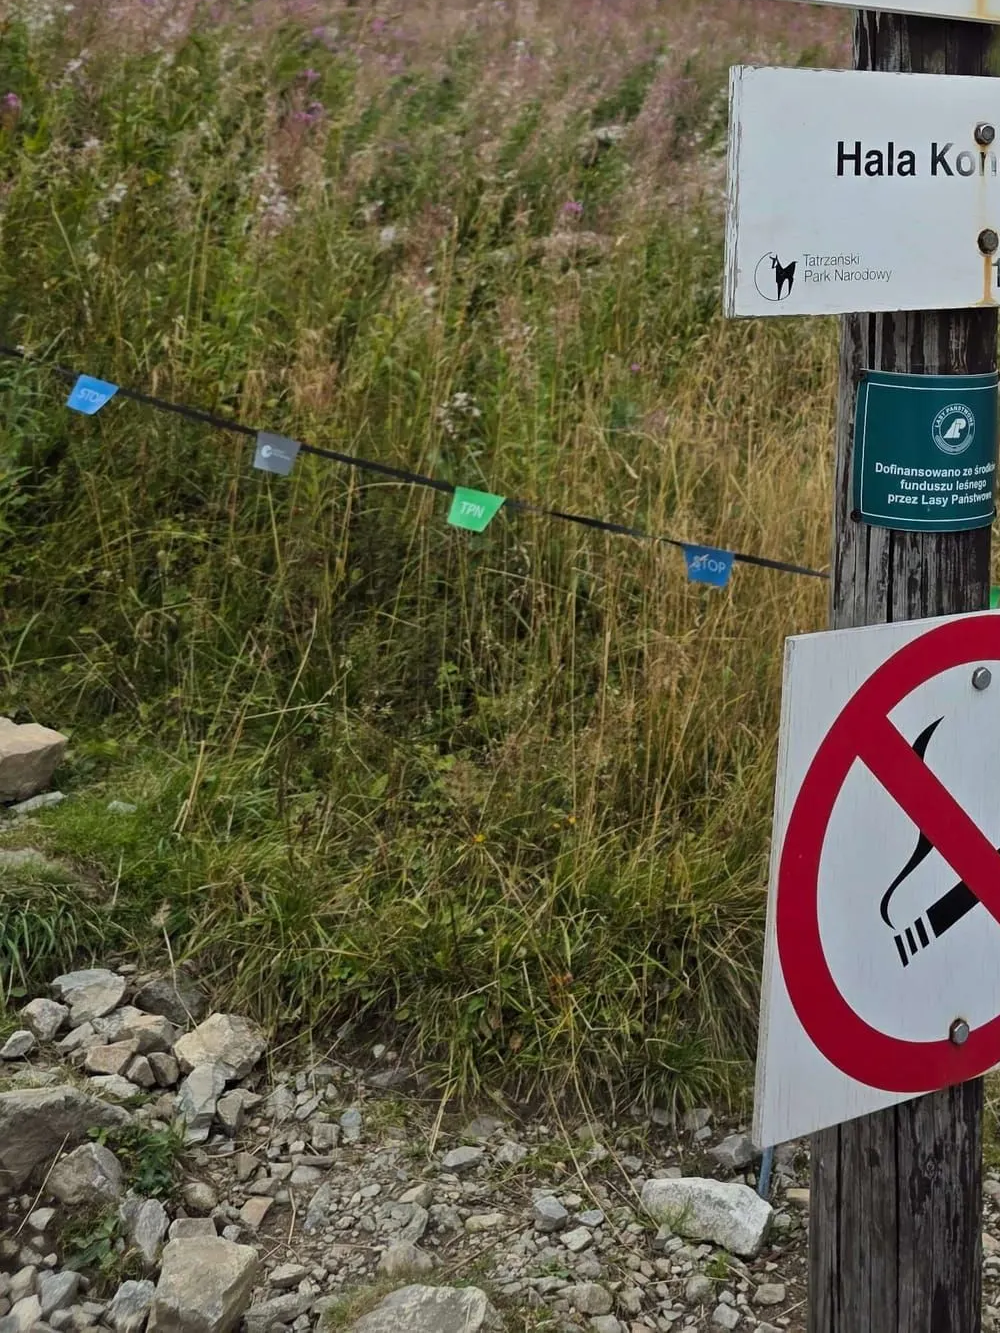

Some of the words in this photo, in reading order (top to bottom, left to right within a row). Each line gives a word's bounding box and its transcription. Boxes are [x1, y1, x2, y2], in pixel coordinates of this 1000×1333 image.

[836, 141, 916, 177] Hala
[803, 252, 861, 266] Tatrzański
[804, 270, 831, 282] Park
[834, 268, 892, 283] Narodowy
[875, 462, 960, 477] Dofinansowano
[962, 467, 973, 477] ze
[900, 478, 953, 491] funduszu
[956, 479, 987, 491] leśnego
[888, 493, 918, 504] przez
[921, 494, 949, 507] Lasy
[460, 501, 486, 519] TPN
